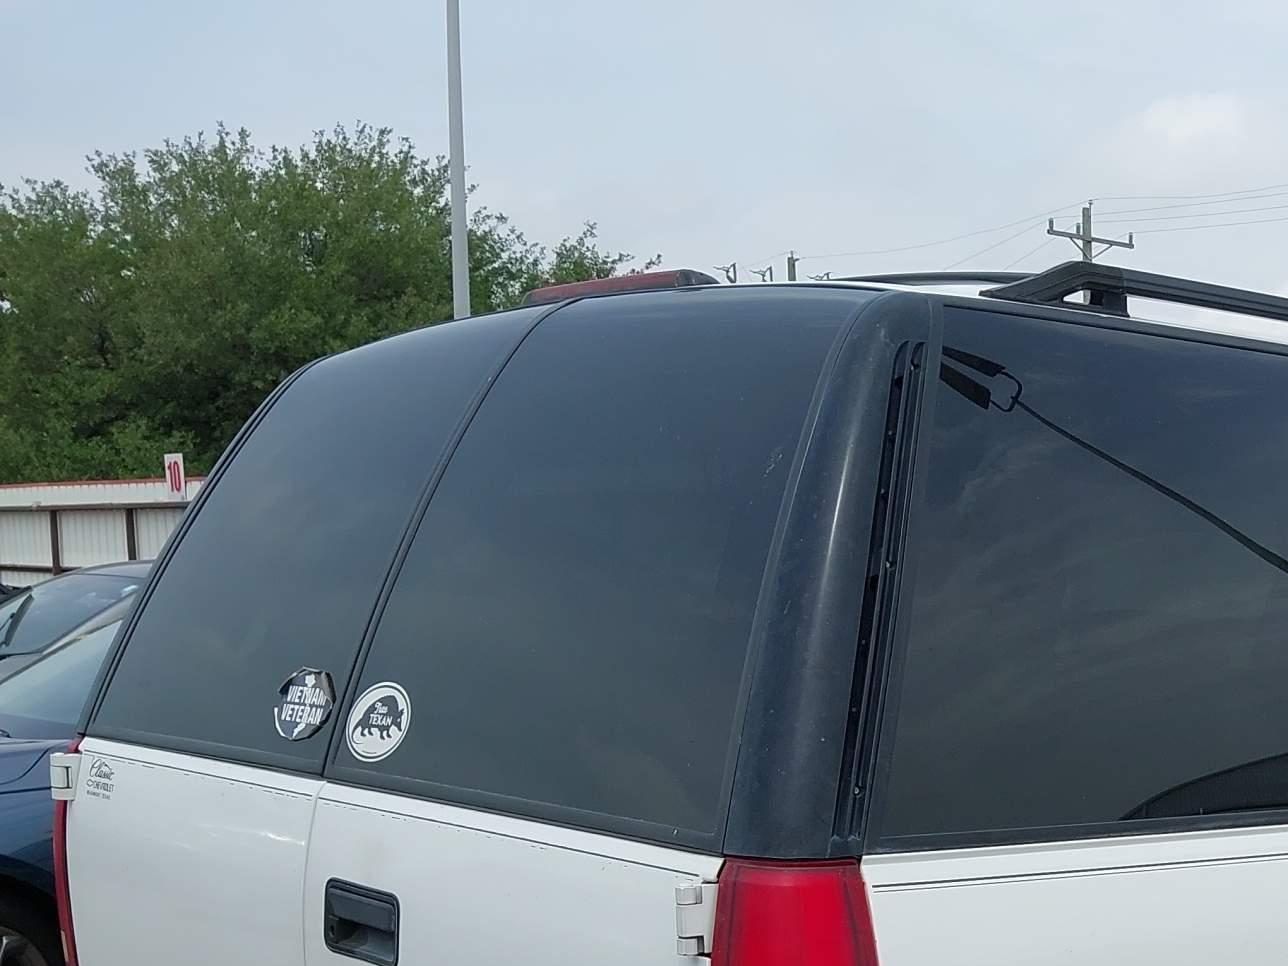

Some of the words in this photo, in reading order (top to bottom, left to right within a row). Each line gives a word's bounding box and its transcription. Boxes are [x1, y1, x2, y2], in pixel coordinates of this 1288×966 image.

[166, 460, 182, 492] 10
[286, 685, 328, 706] VIETNAM
[281, 703, 323, 725] VETERAN
[369, 713, 393, 726] TEXAN
